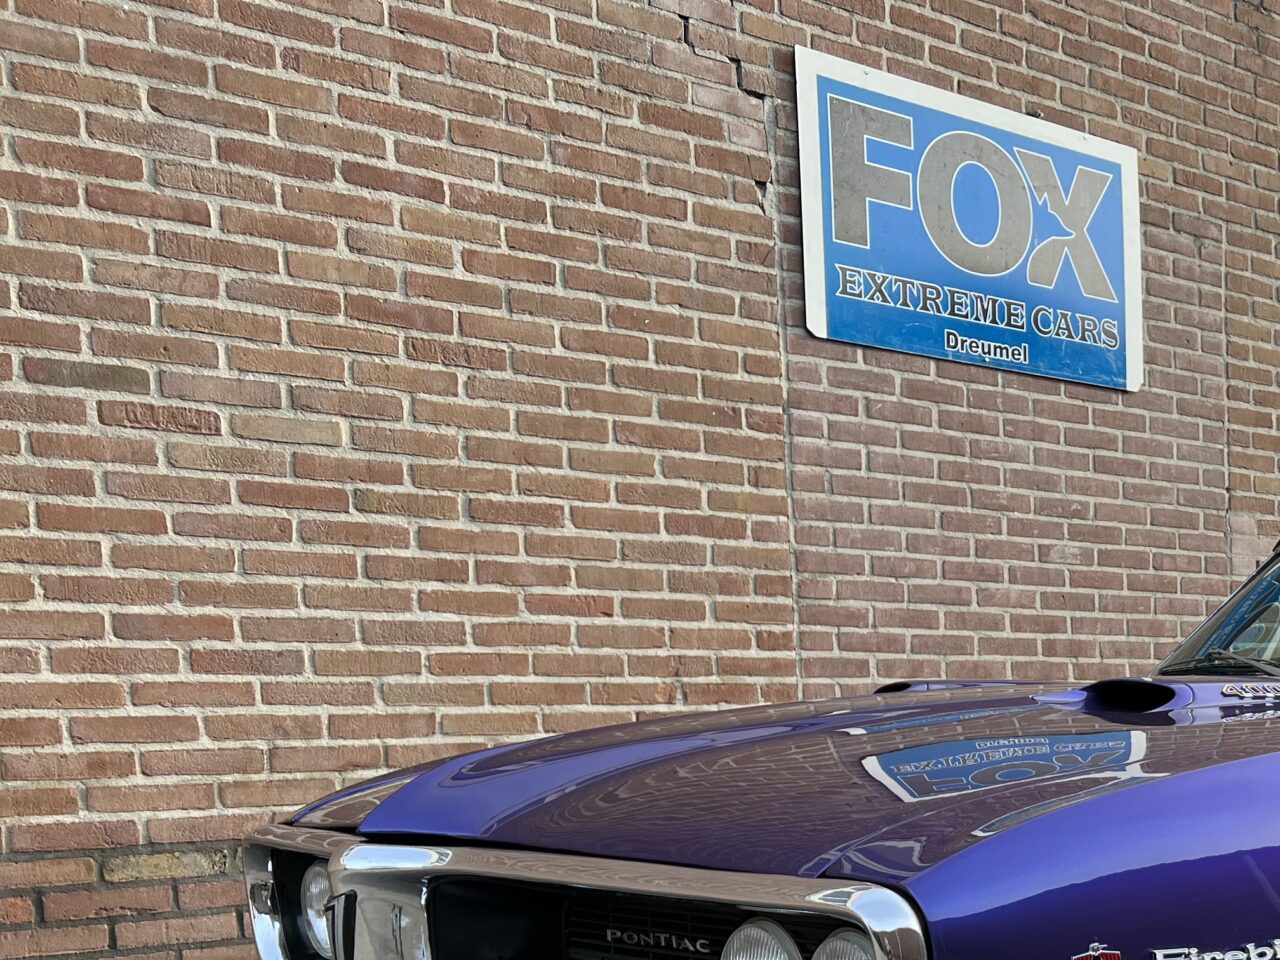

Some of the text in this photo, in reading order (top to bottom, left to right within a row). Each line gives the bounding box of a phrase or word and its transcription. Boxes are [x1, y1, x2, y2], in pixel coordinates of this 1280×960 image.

[827, 93, 1118, 303] FOX
[834, 263, 1119, 349] EXTREME CARS
[944, 329, 1029, 363] Dreumel
[606, 929, 710, 953] PONTIAC
